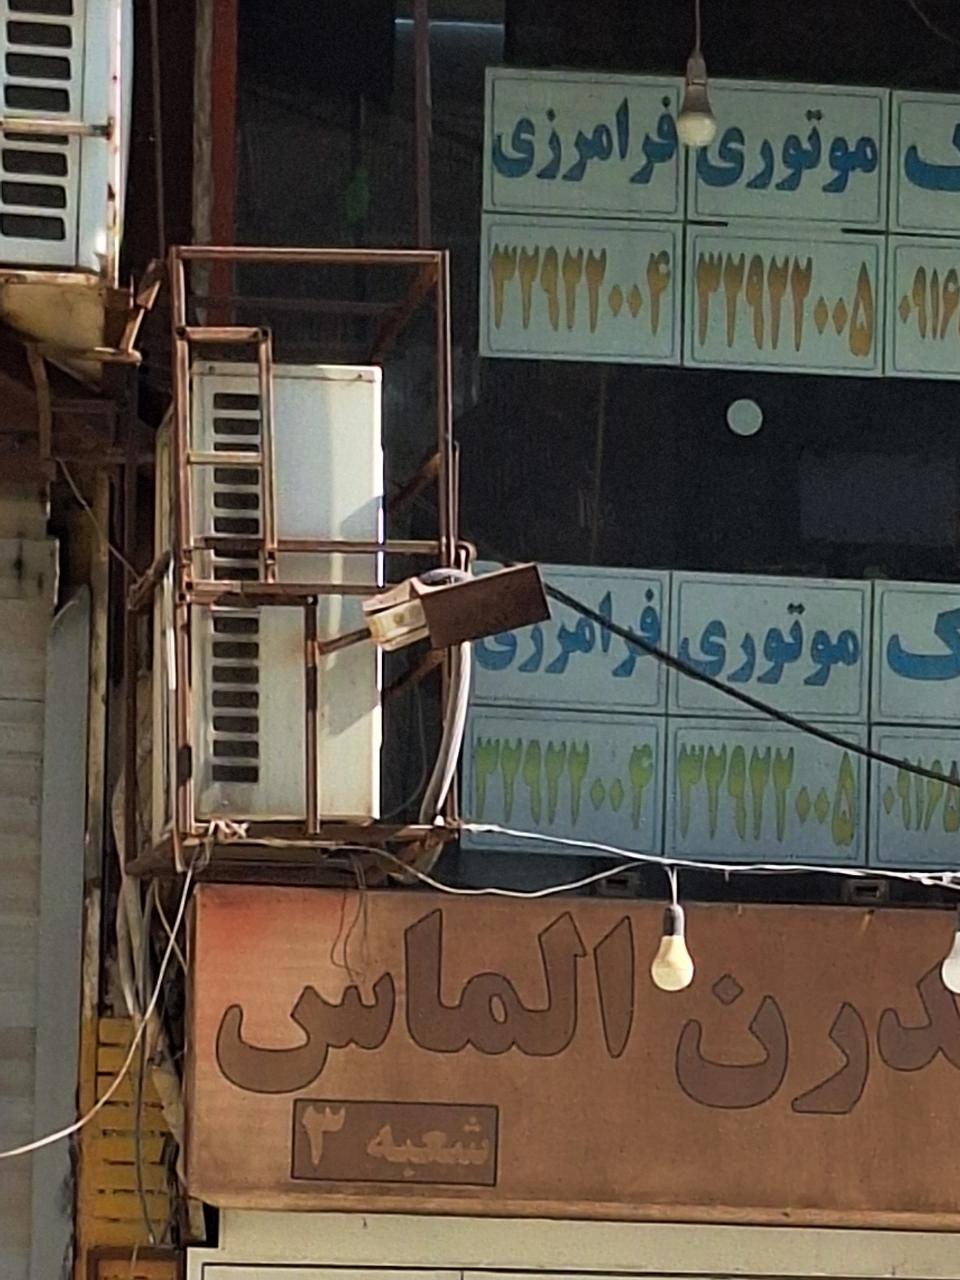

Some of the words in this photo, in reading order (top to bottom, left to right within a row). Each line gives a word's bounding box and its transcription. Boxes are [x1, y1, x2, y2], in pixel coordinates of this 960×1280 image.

[492, 96, 678, 184] فرامرزی
[697, 109, 878, 192] موتوری
[678, 603, 859, 686] موتوری
[216, 909, 634, 1093] الماس
[301, 1105, 346, 1166] ۳
[367, 1115, 489, 1177] شعبه
